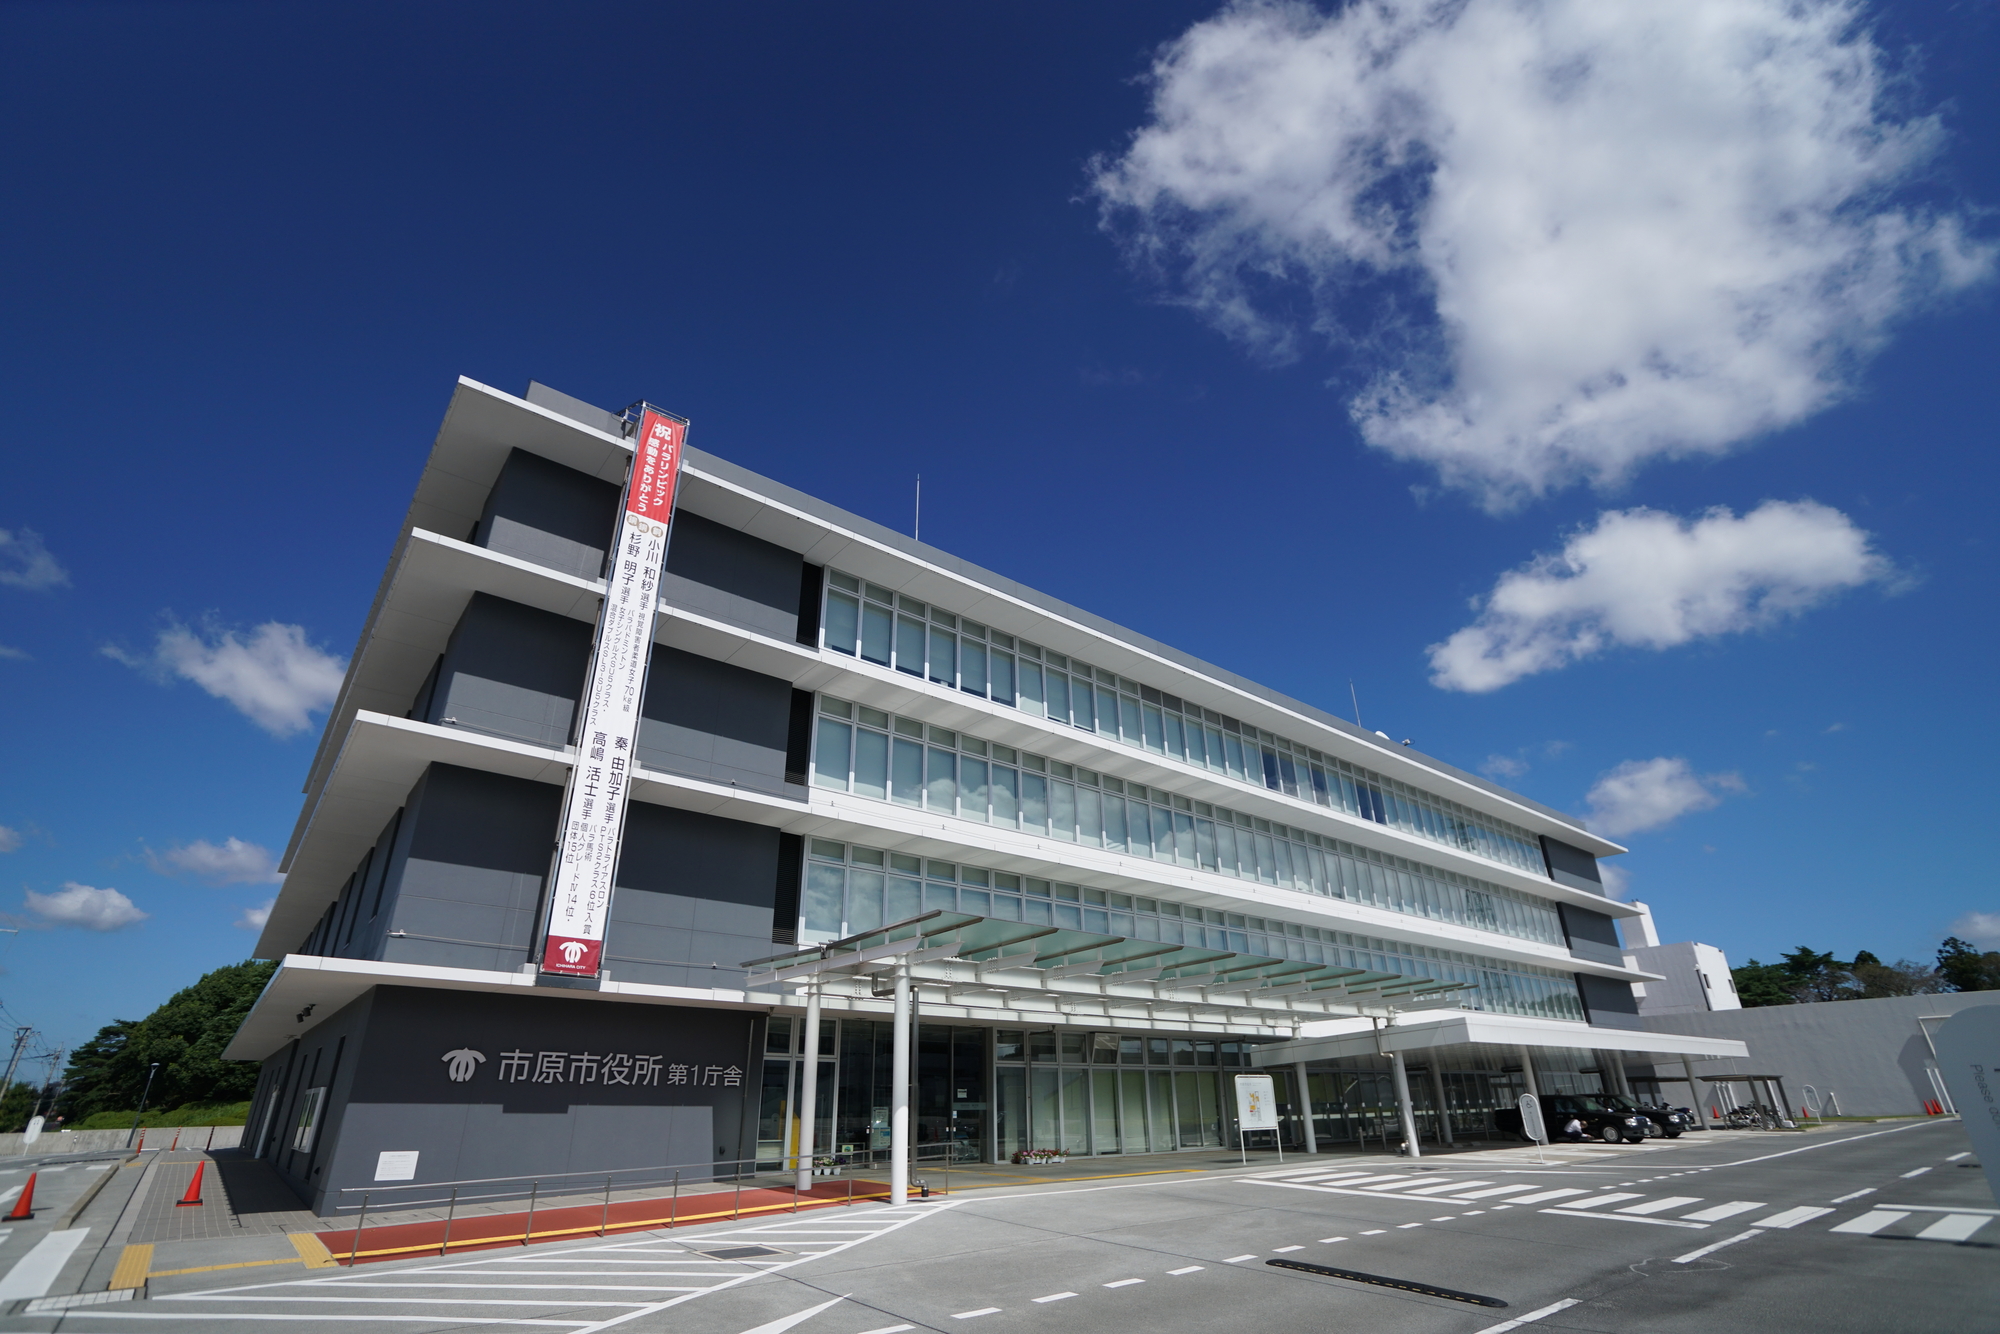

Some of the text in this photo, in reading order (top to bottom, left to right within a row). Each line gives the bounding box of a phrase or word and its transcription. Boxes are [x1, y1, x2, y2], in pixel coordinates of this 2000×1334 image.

[654, 423, 672, 441] 祝
[637, 437, 660, 512] 感動をありがとう
[653, 443, 674, 506] パラリンピック
[627, 531, 642, 558] 杉野
[645, 539, 660, 565] 小川
[590, 731, 608, 762] 高嶋
[584, 824, 597, 862] パラ馬術
[596, 827, 616, 909] パラトライアスロン
[498, 1048, 743, 1087] 市原市役所 第1庁舎
[1969, 1064, 1994, 1103] Please
